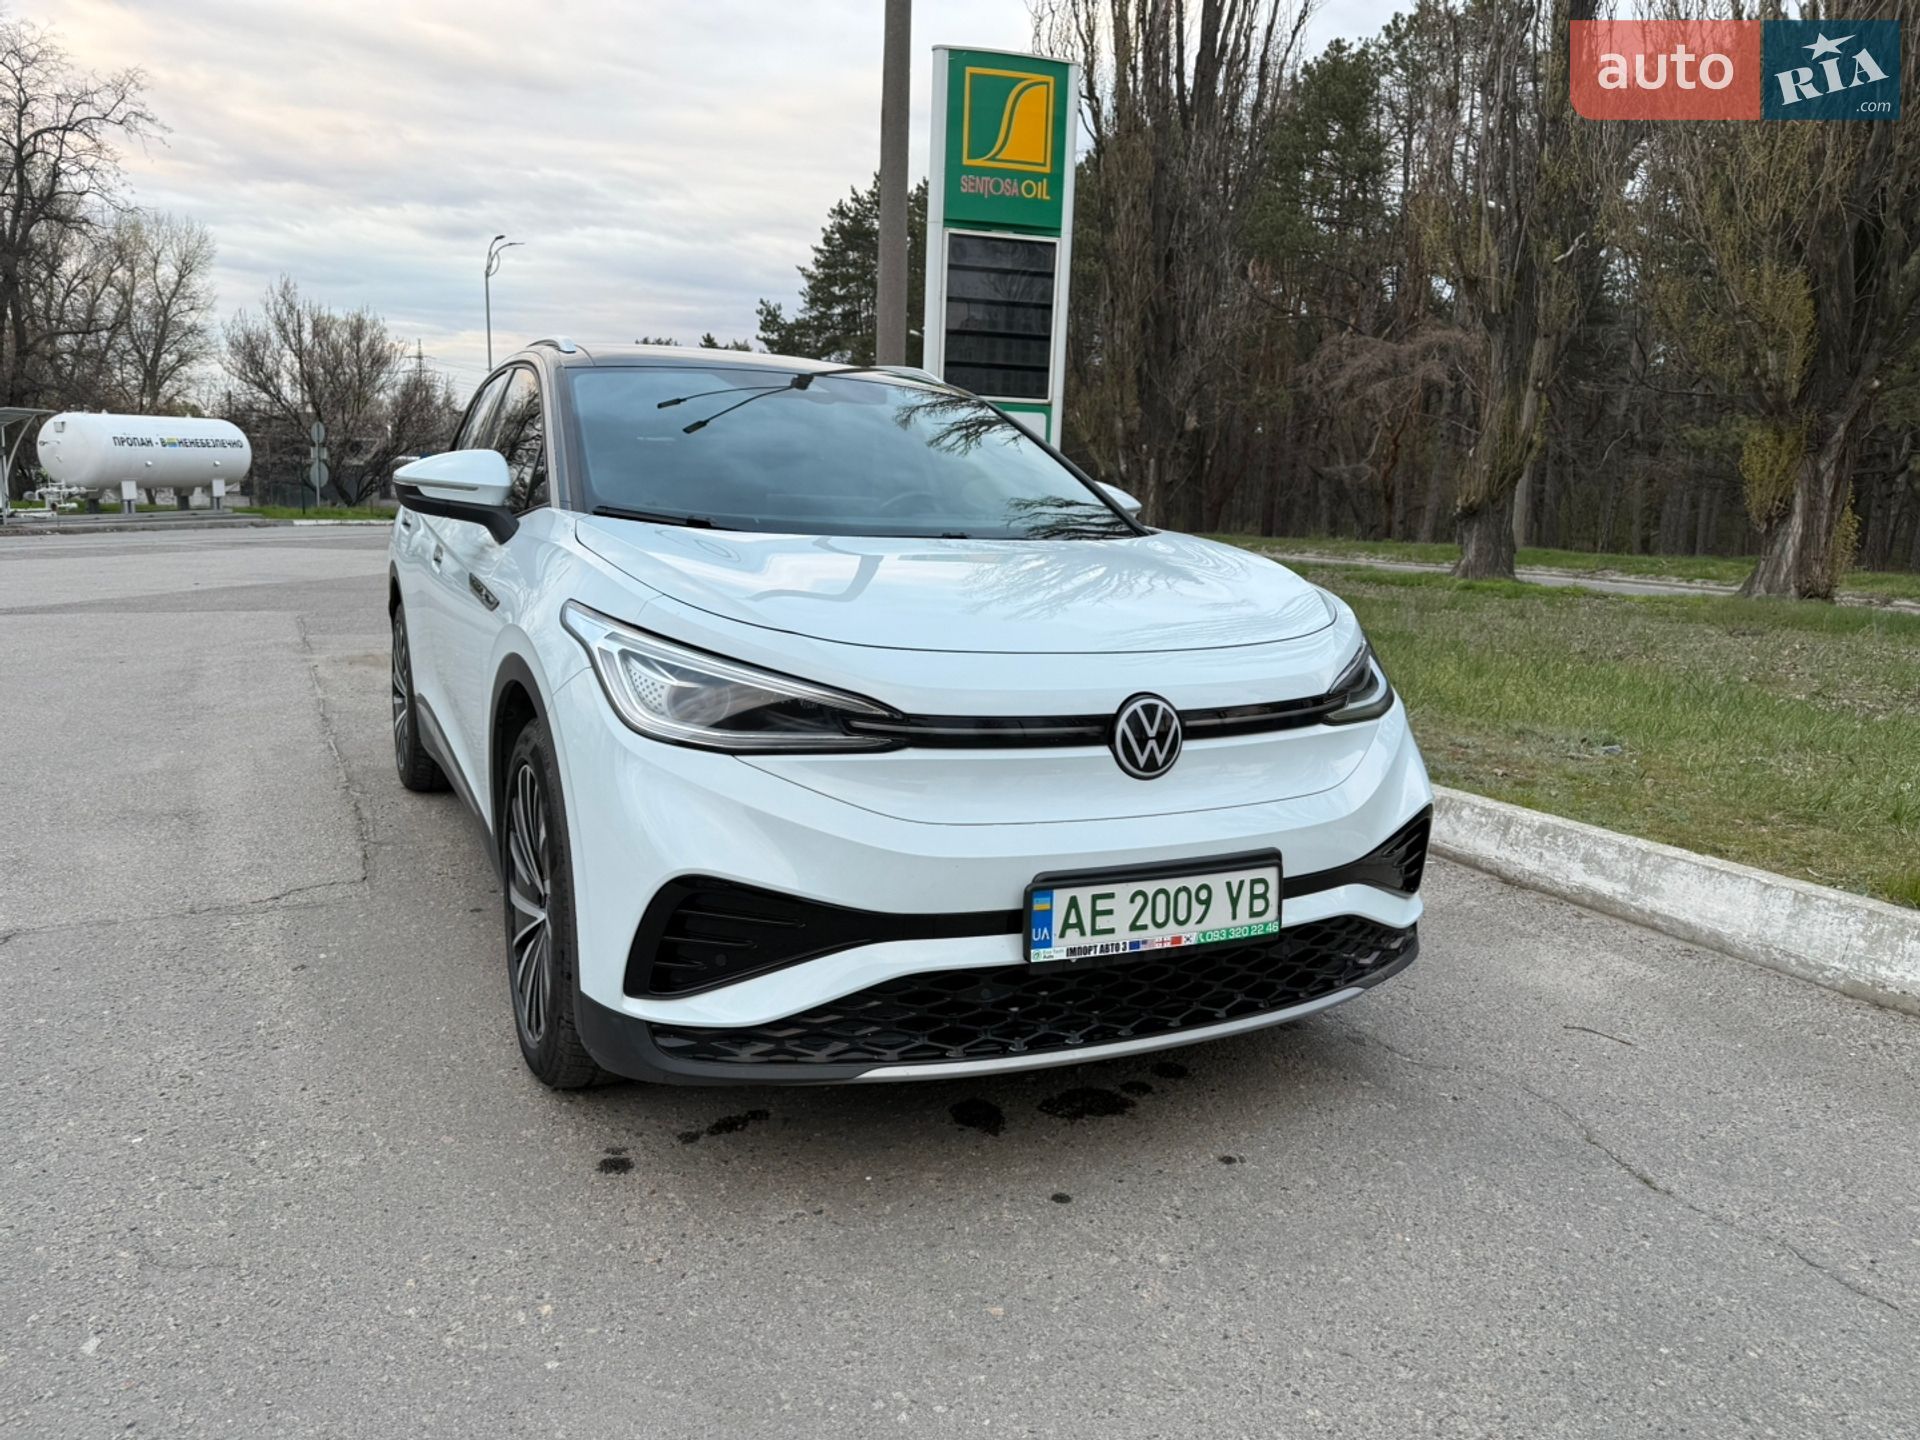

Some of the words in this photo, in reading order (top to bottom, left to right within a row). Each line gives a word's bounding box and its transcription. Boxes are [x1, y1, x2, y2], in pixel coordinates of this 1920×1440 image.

[1021, 177, 1051, 200] OIL
[112, 436, 154, 447] ПРОПАН
[1116, 698, 1181, 775] VW
[1058, 892, 1116, 939] AE
[1129, 883, 1213, 932] 2009
[1032, 927, 1050, 941] UA
[1206, 930, 1227, 942] 093
[1229, 926, 1249, 939] 320
[1250, 924, 1264, 935] 22
[1266, 921, 1279, 933] 46
